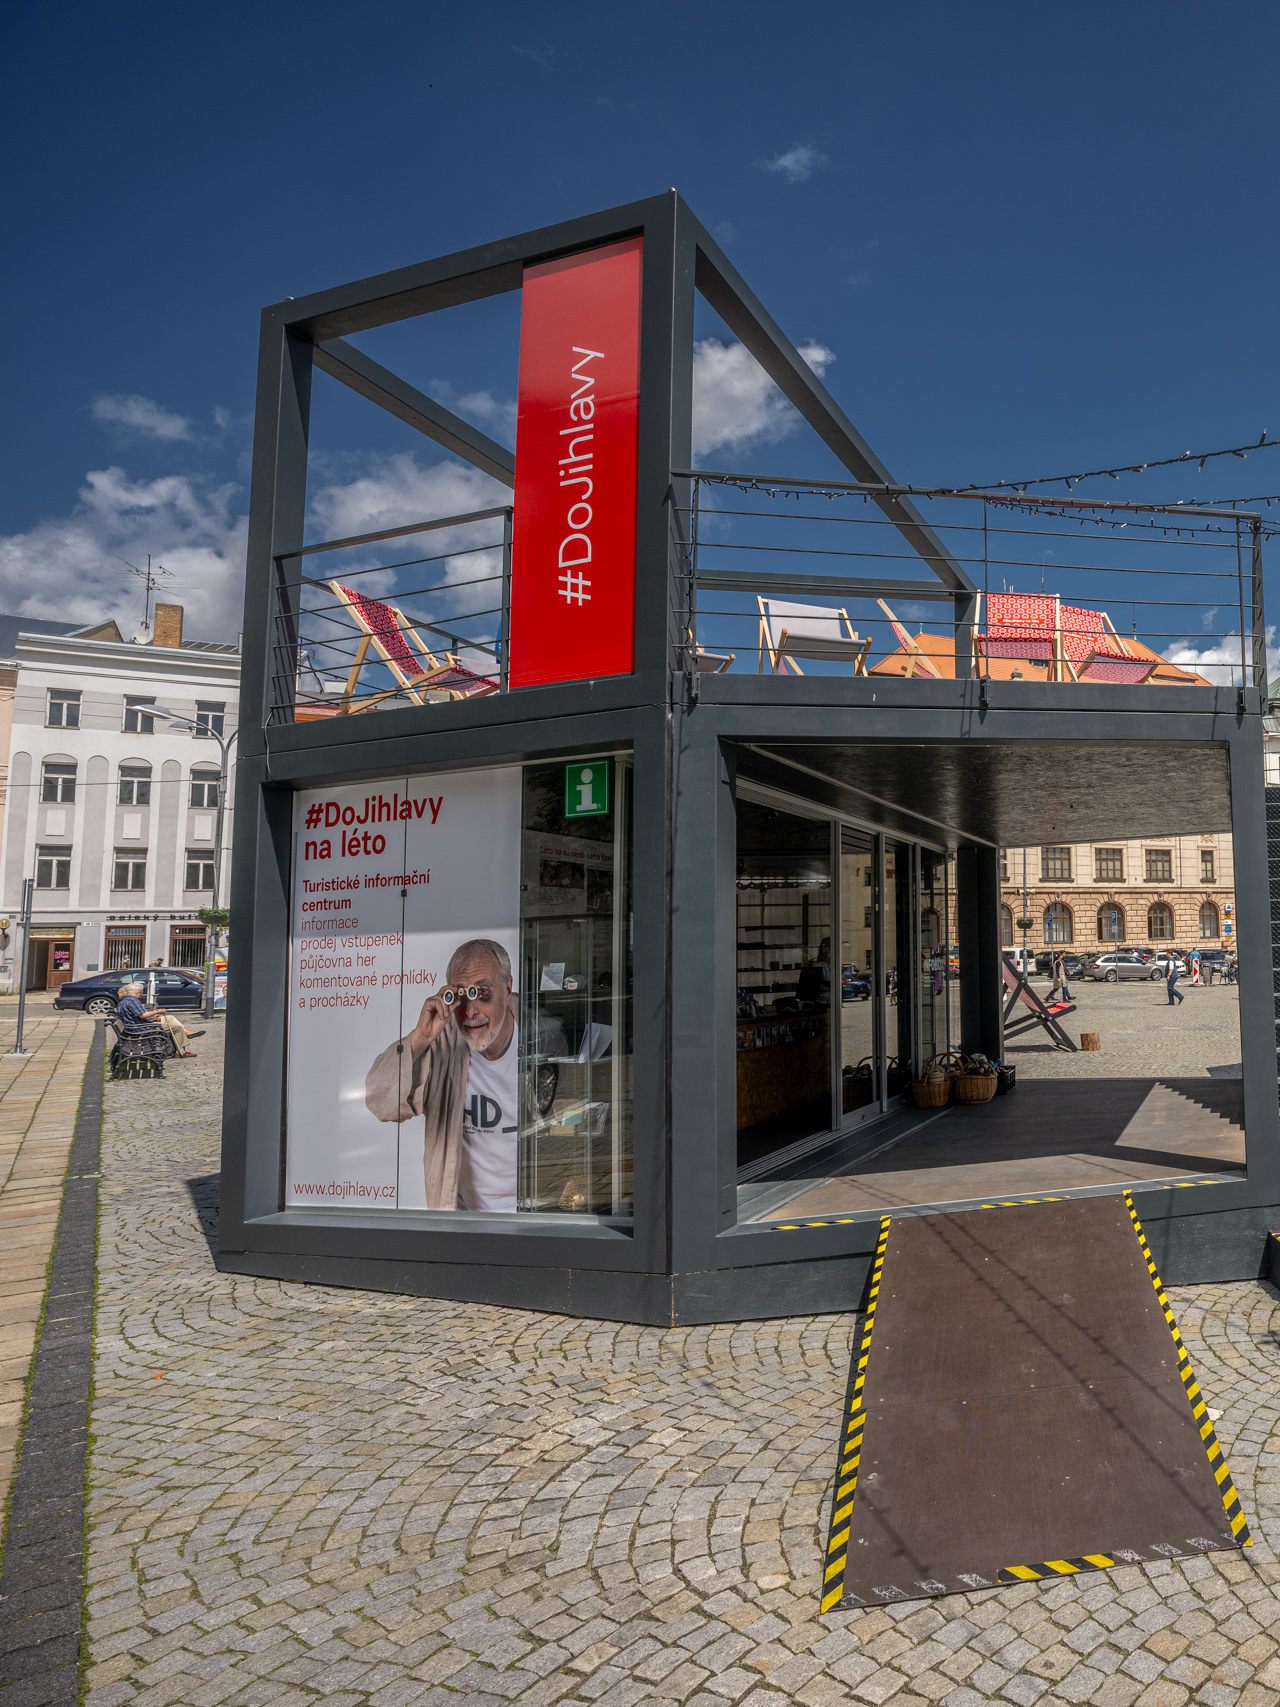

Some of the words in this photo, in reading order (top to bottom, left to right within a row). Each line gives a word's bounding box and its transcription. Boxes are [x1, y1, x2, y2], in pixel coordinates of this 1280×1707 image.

[558, 346, 605, 606] #DoJihlavy
[304, 793, 444, 829] #DoJihlavy
[304, 839, 332, 861] na
[341, 828, 386, 858] léto
[303, 874, 360, 893] Turistické
[364, 868, 431, 889] informační
[302, 898, 352, 912] centrum
[301, 916, 359, 931] informace
[301, 935, 337, 953] prodej
[341, 931, 403, 951] vstupenek
[300, 954, 352, 972] půjčovna
[356, 952, 377, 967] her
[299, 971, 378, 989] komentované
[382, 969, 438, 989] prohlídky
[298, 996, 306, 1009] a
[310, 991, 370, 1011] procházky
[293, 1180, 396, 1201] www.dojihlavy.cz
